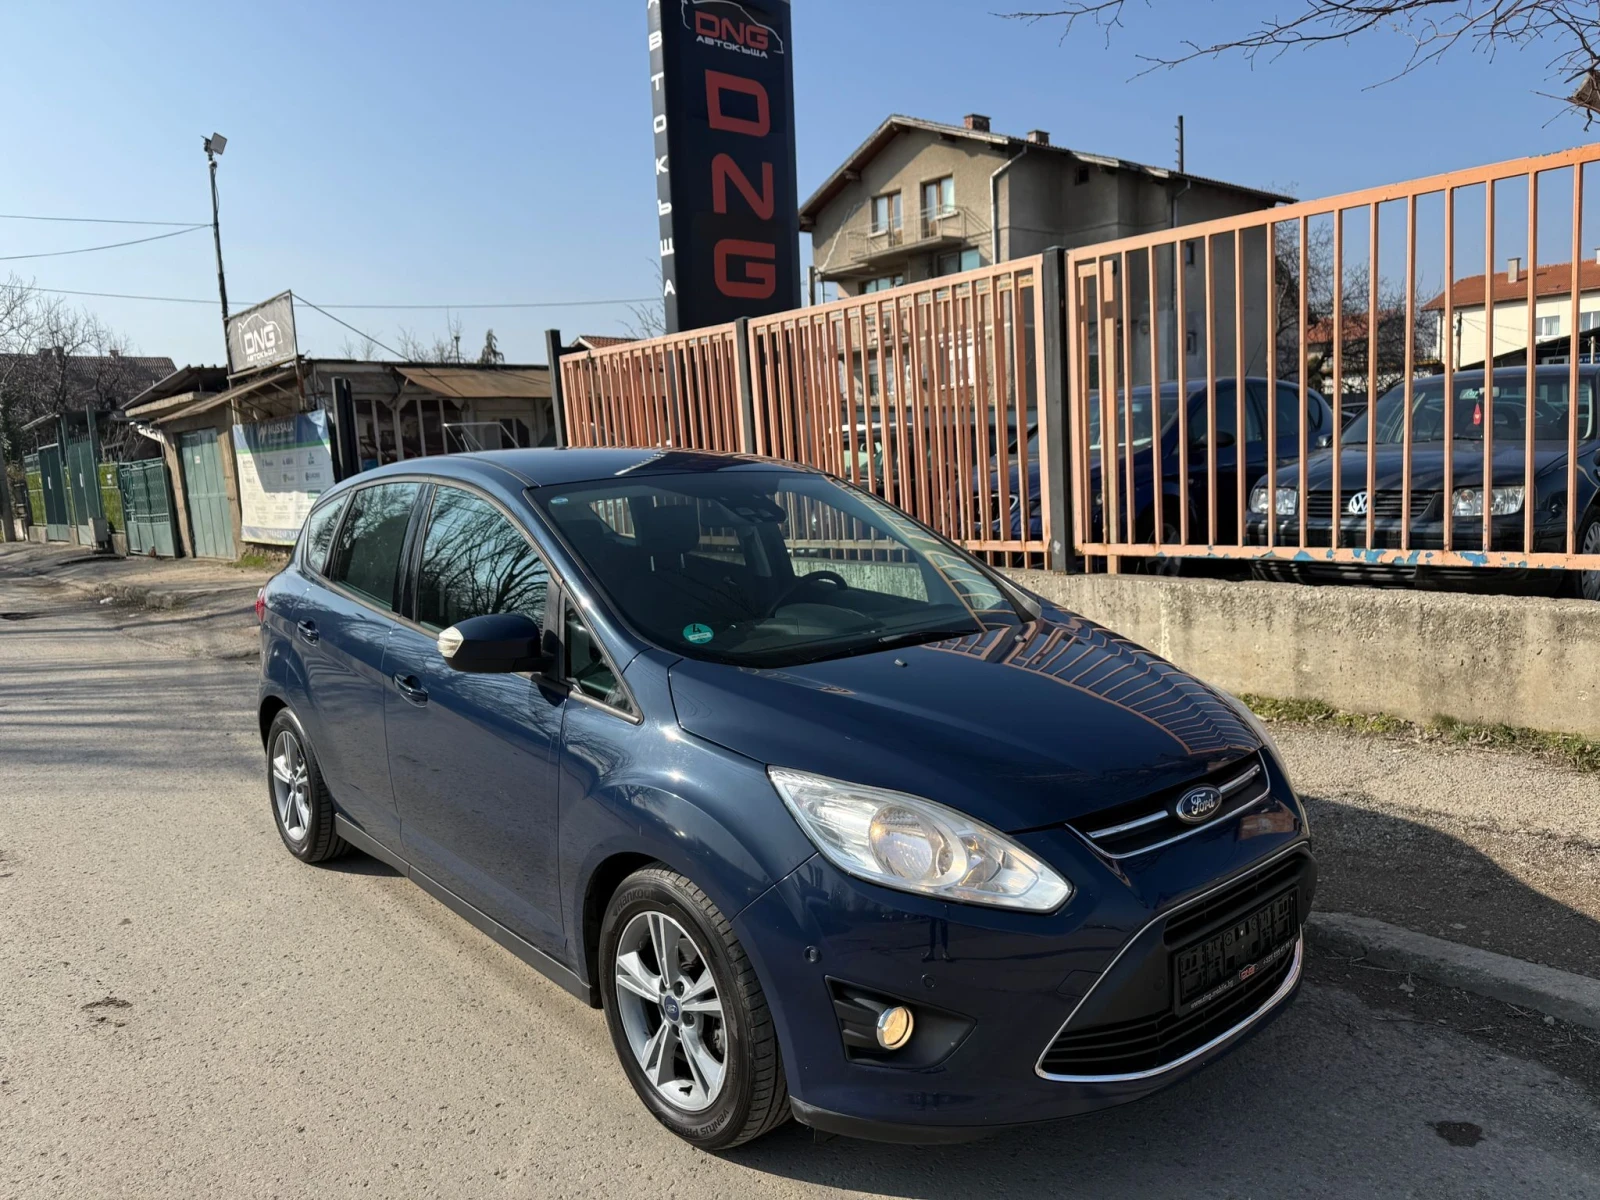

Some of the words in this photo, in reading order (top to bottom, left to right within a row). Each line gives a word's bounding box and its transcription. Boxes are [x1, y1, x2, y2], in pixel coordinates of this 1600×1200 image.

[695, 10, 768, 50] DNG
[696, 35, 768, 59] АВТОКЪША
[704, 69, 775, 299] DNG
[244, 324, 276, 355] DNG
[1190, 792, 1215, 815] Ford
